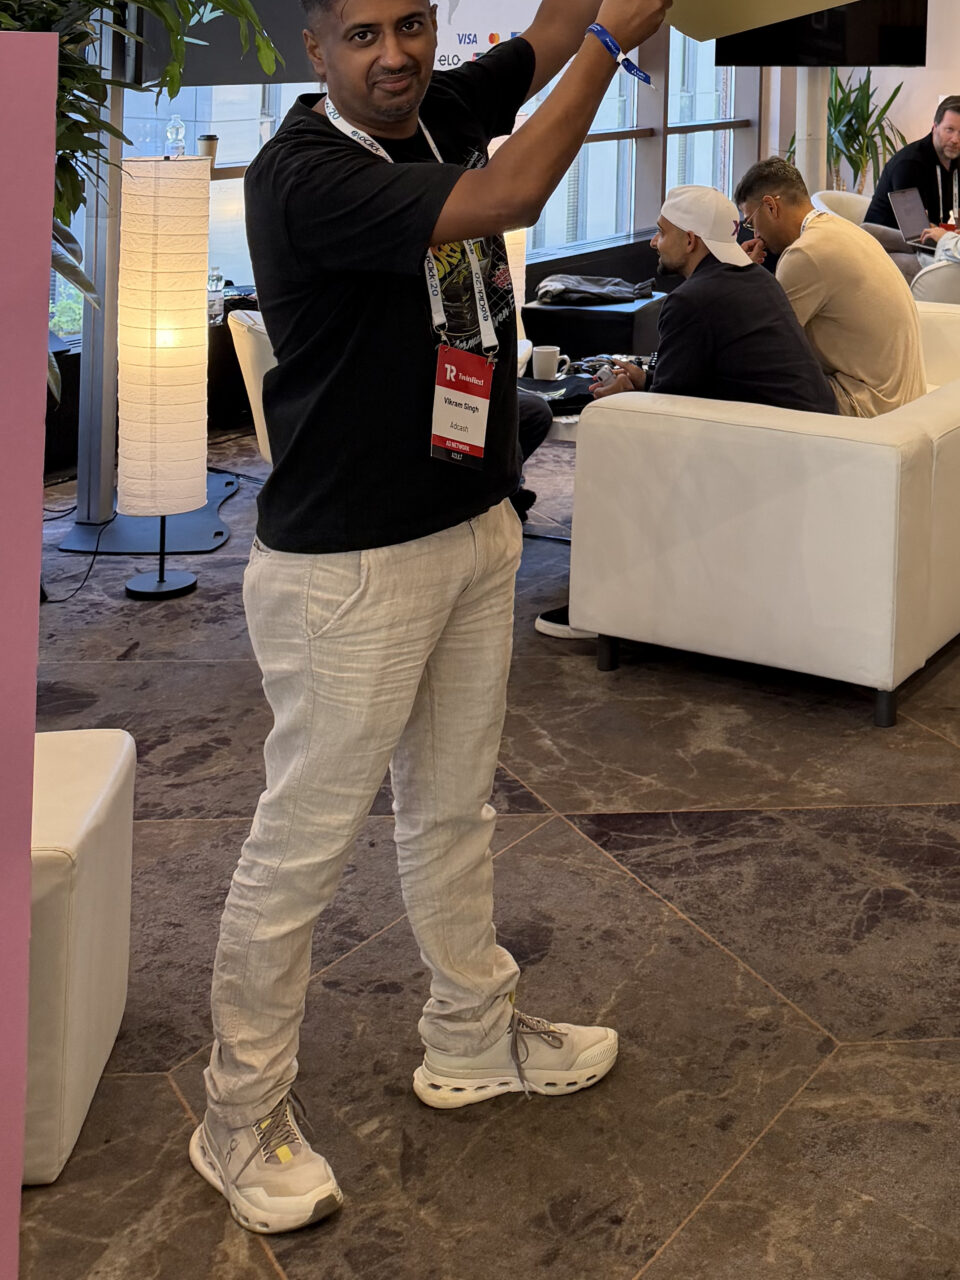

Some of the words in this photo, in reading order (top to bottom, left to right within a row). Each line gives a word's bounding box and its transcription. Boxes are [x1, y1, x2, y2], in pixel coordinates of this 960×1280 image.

[457, 33, 478, 45] VISA
[328, 107, 341, 121] 20
[474, 272, 483, 286] 20
[430, 282, 439, 297] 20
[476, 289, 489, 322] exoClick
[444, 397, 463, 410] Vikram
[463, 403, 480, 414] Singh
[449, 422, 469, 433] Adcash
